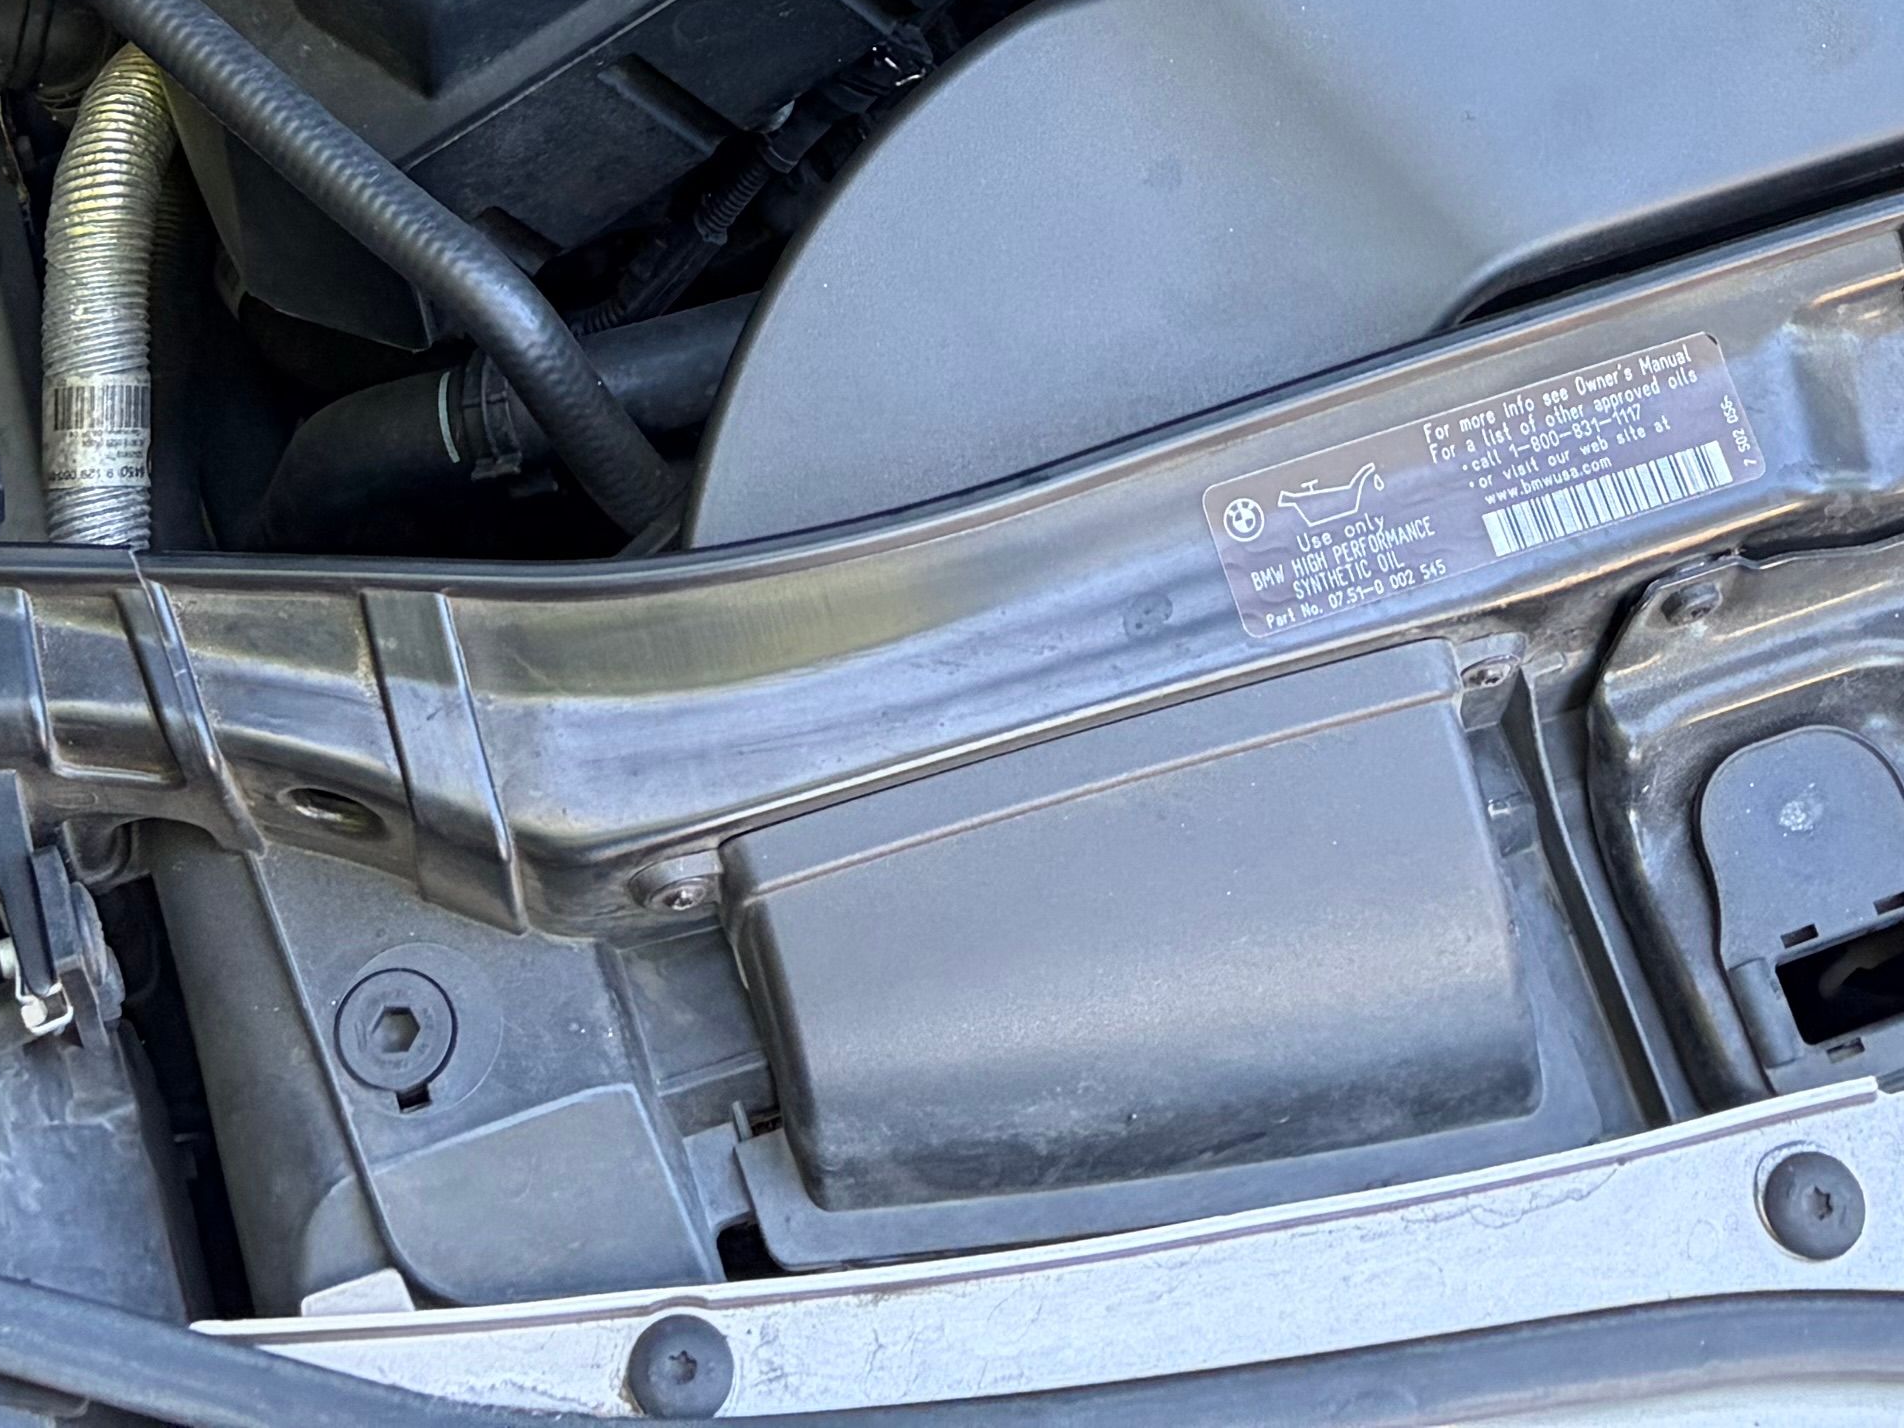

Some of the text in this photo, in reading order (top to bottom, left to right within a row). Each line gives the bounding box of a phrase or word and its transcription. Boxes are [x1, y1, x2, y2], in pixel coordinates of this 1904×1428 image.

[1423, 423, 1450, 443] For
[1459, 410, 1496, 432] more
[1543, 388, 1569, 407] see
[1574, 363, 1633, 396] Owner's
[1638, 344, 1692, 376] Manual
[1429, 367, 1698, 464] For a list of other approved oils
[1502, 456, 1539, 480] visit
[1547, 450, 1570, 467] our
[1579, 435, 1609, 456] web
[1616, 425, 1647, 445] site
[1653, 415, 1671, 433] at
[1508, 403, 1641, 458] 1-800-831-1117
[1732, 428, 1751, 453] 502
[1484, 456, 1613, 505] www.bmwusa.com
[1250, 515, 1436, 592] BMW HIGH PERFORMANCE
[1297, 514, 1385, 552] Use only
[1265, 607, 1296, 629] Part
[1301, 602, 1324, 619] No.
[1389, 569, 1416, 590] 002
[1420, 558, 1447, 580] 545
[1292, 550, 1405, 600] SYNTHETIC OIL
